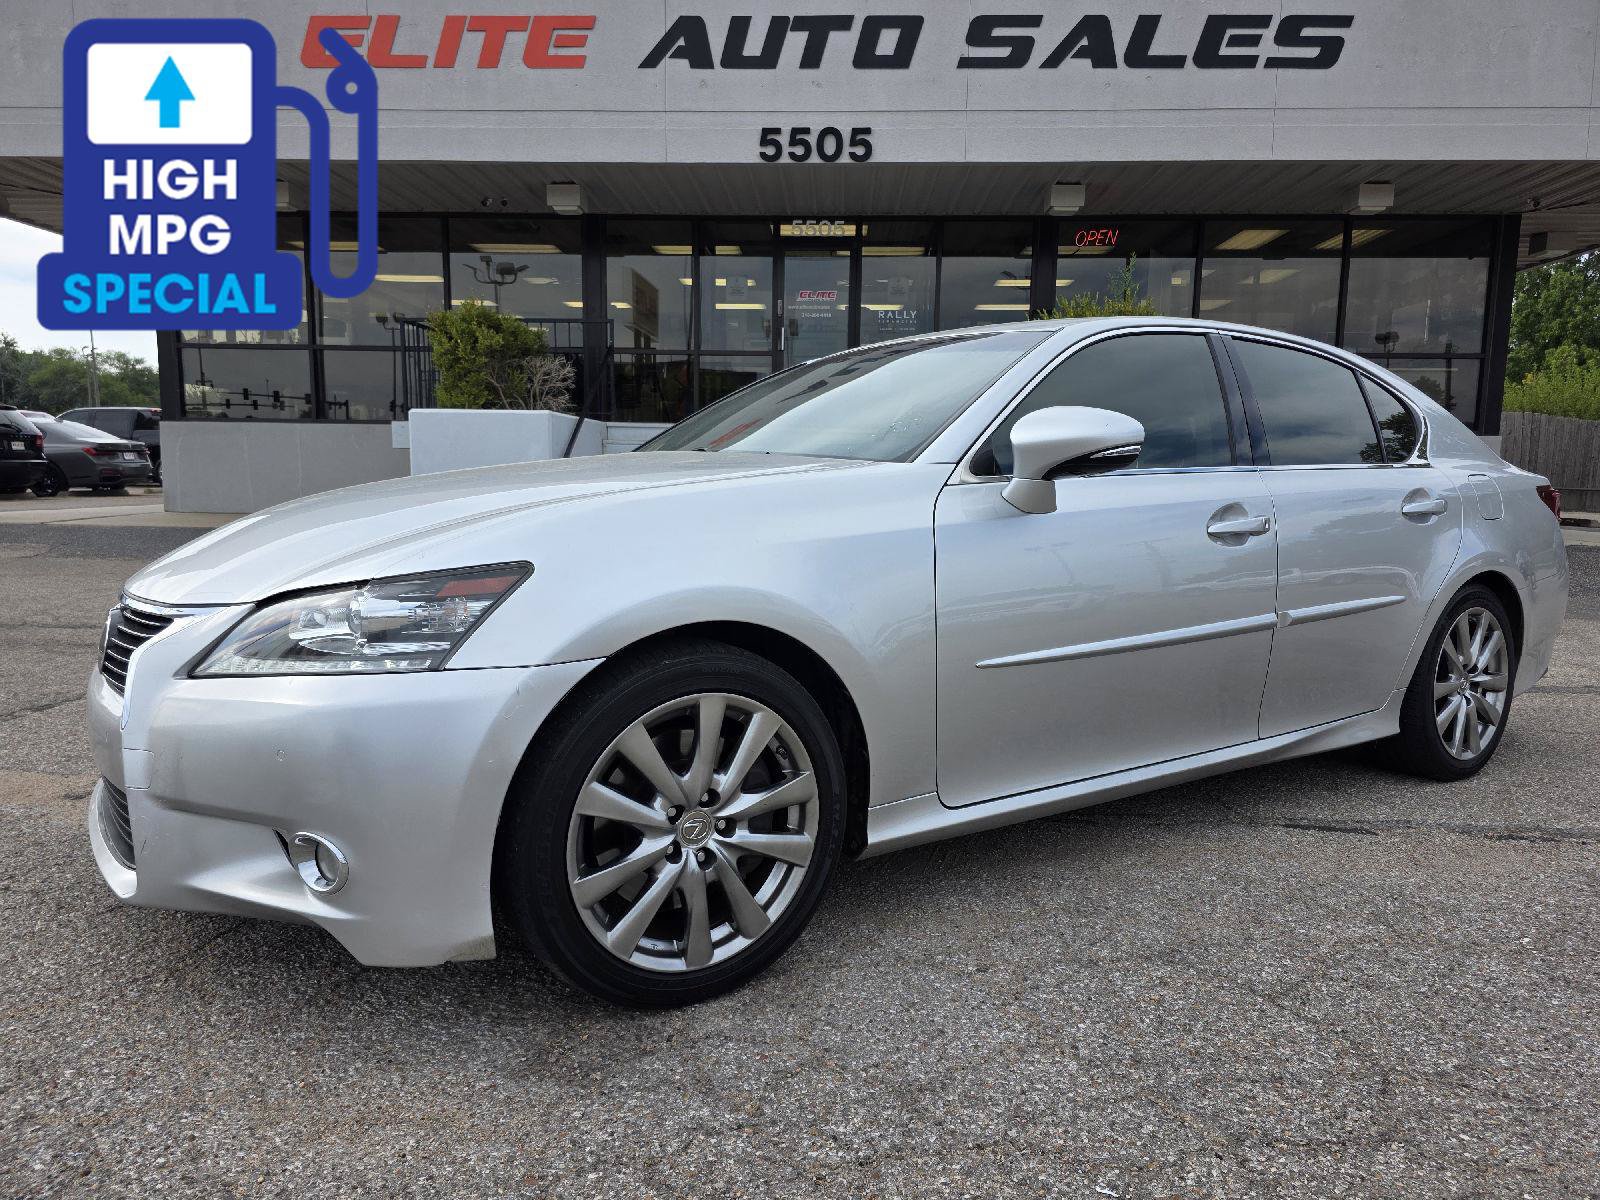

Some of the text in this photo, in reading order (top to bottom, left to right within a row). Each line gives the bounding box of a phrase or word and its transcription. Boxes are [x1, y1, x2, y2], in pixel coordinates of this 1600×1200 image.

[300, 15, 1355, 69] ELITE AUTO SALES
[758, 127, 874, 163] 5505
[792, 220, 846, 237] 5505
[1075, 229, 1119, 247] OPEN
[878, 310, 917, 319] RALLY
